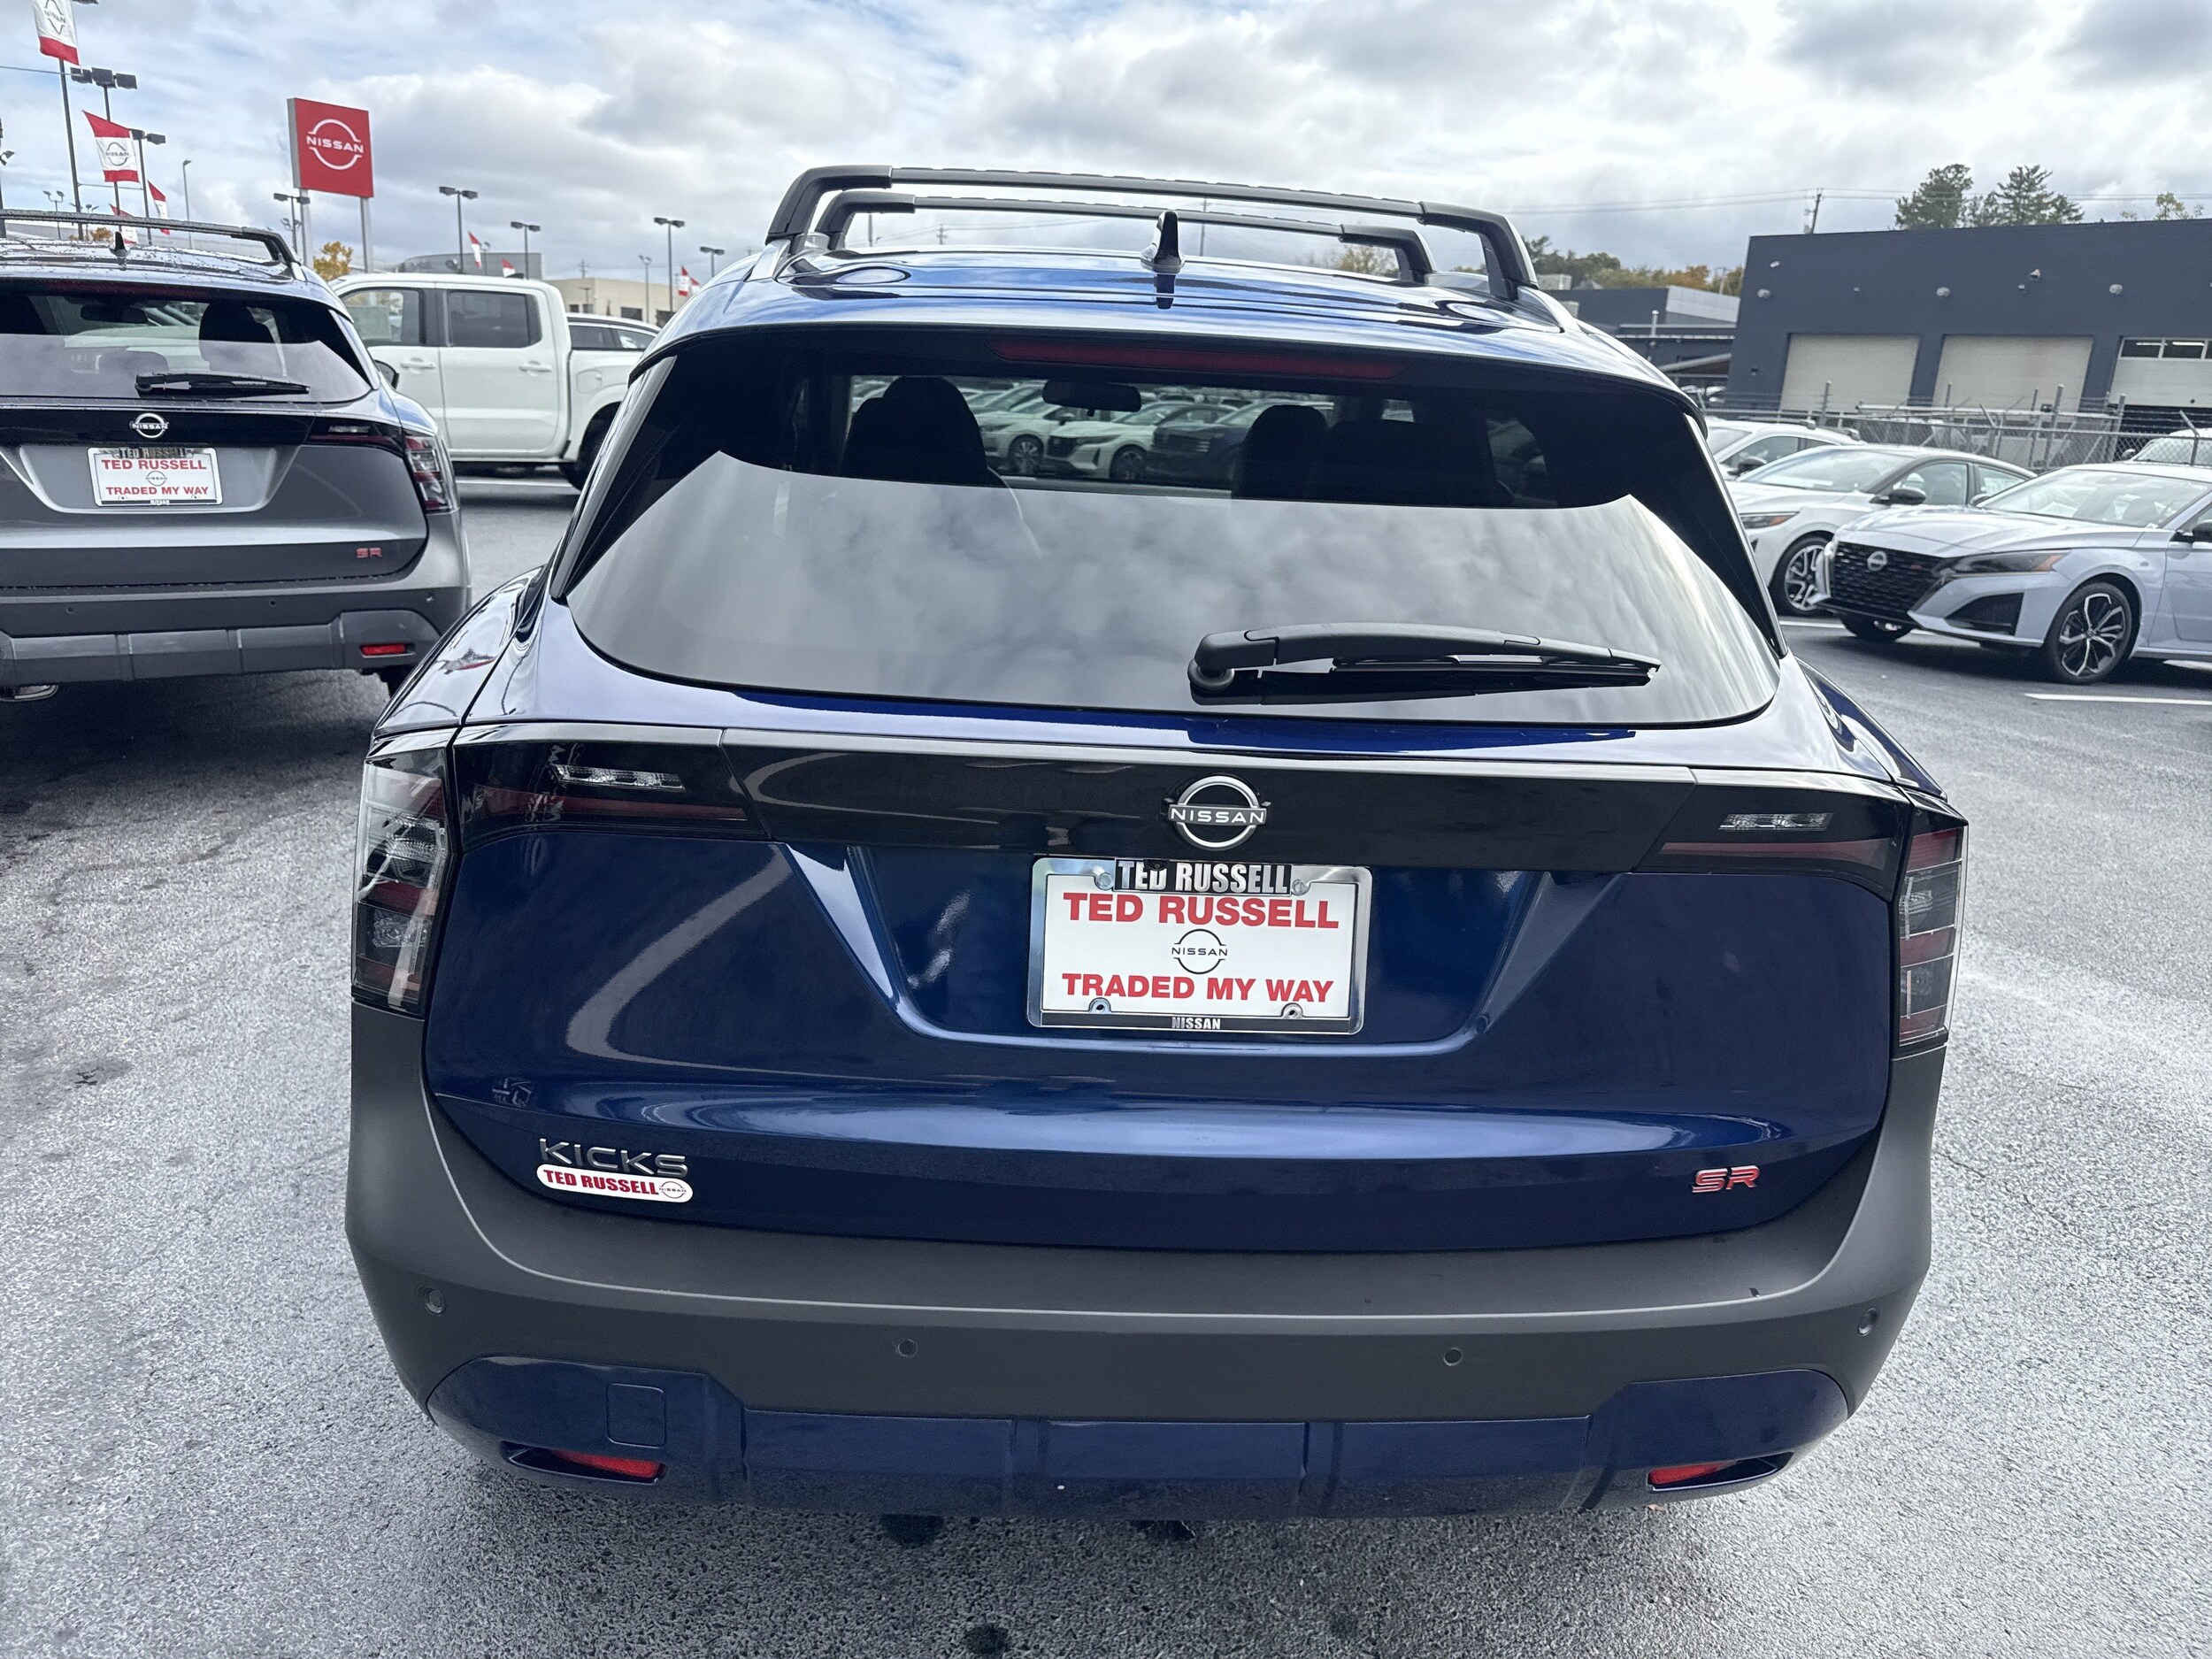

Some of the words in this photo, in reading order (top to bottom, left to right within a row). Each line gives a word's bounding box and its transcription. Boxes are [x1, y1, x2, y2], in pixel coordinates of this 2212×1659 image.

[306, 135, 364, 154] NISSAN
[119, 448, 140, 458] TED
[101, 459, 133, 470] TED
[138, 459, 207, 470] RUSSELL
[106, 487, 157, 495] TRADED
[356, 547, 383, 558] SR
[1171, 808, 1264, 824] NISSAN
[1118, 860, 1167, 890] TED
[1175, 862, 1287, 894] RUSSELL
[1063, 892, 1143, 923] TED
[1158, 895, 1339, 929] RUSSELL
[1171, 947, 1228, 956] NISSAN
[1062, 973, 1194, 1000] TRADED
[1207, 978, 1256, 1001] MY
[1266, 979, 1334, 1002] WAY
[1171, 1017, 1221, 1030] NISSAN
[539, 1138, 688, 1178] KICKS
[543, 1169, 578, 1187] TED
[580, 1174, 660, 1195] RUSSELL
[1692, 1164, 1760, 1194] SR
